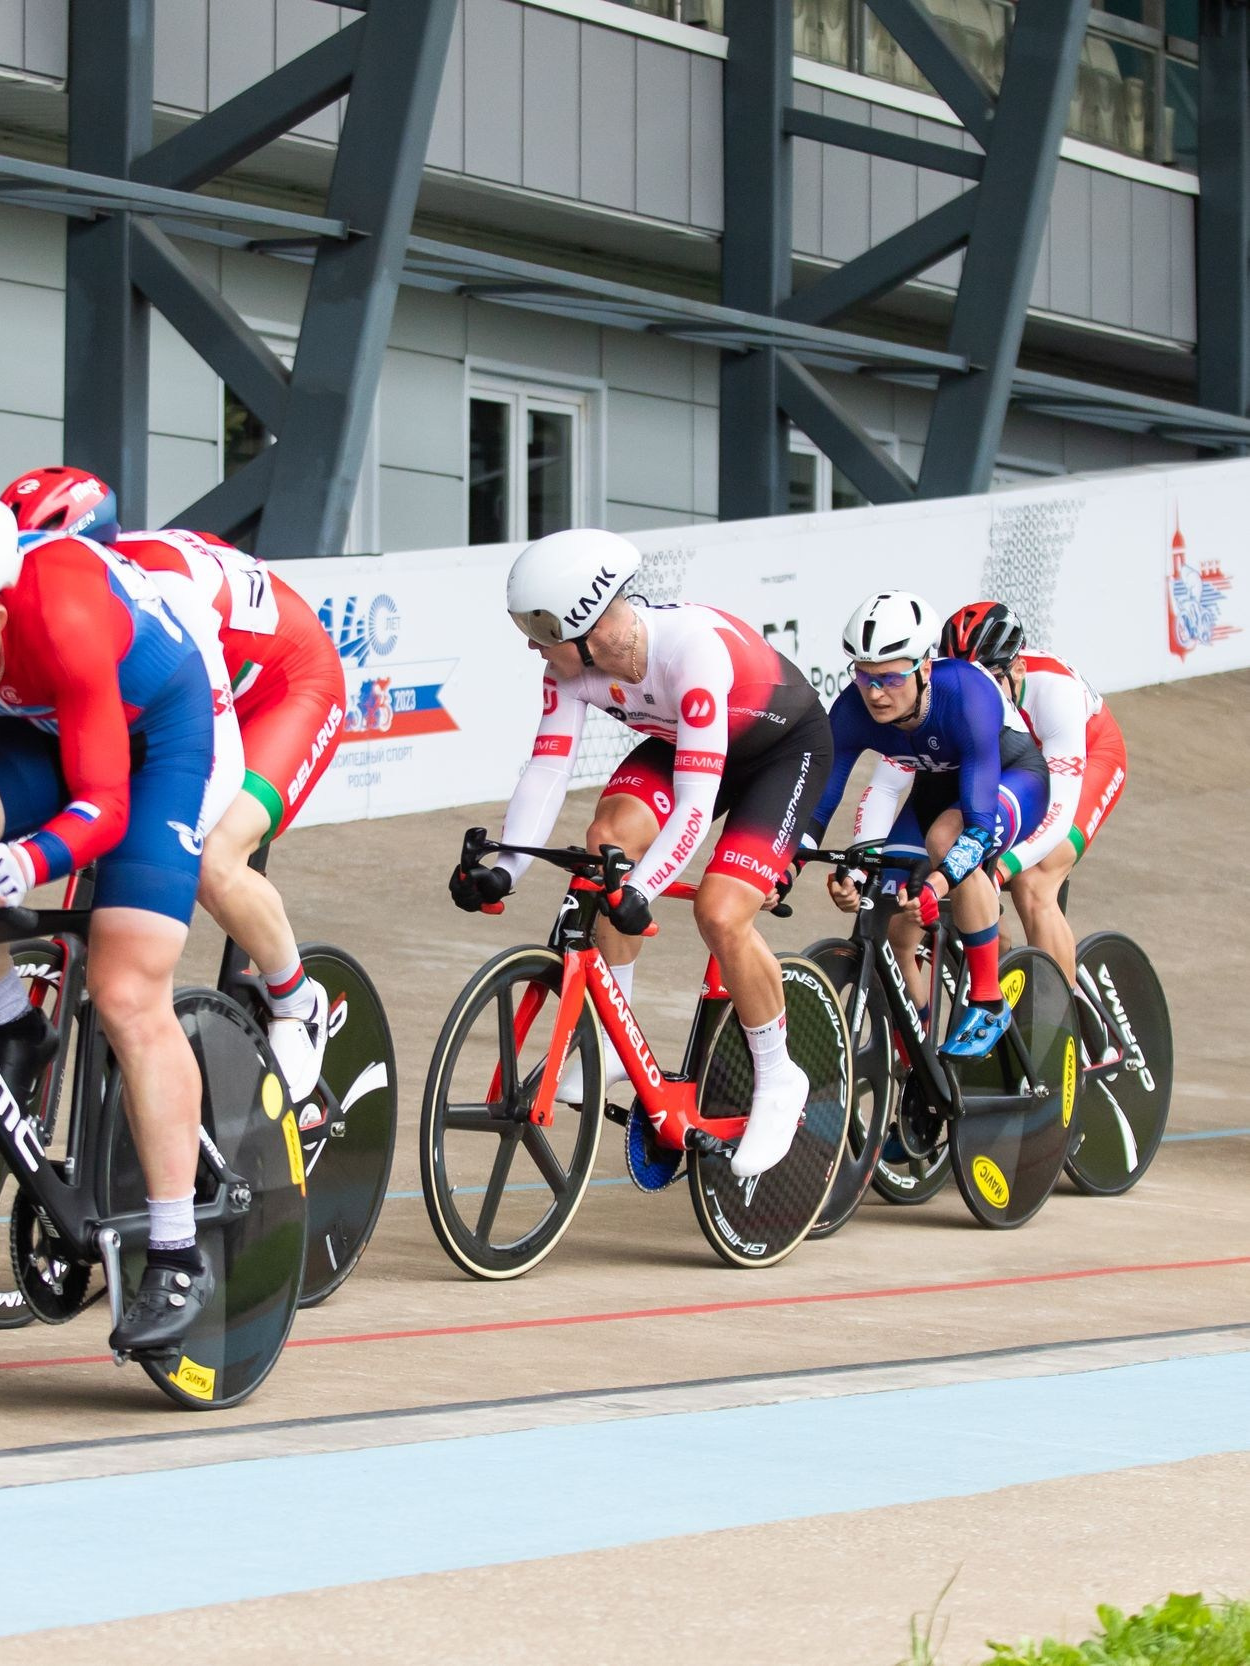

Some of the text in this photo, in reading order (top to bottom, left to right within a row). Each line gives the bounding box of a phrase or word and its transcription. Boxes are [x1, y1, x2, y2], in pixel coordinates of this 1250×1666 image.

[564, 566, 616, 628] KASK
[287, 703, 343, 806] BELARUS
[387, 746, 413, 762] СПОРТ
[675, 755, 724, 771] BIEMME
[1026, 802, 1063, 845] BELARUS
[1086, 767, 1126, 840] BELARUS
[647, 807, 704, 891] TULA REGION
[592, 953, 661, 1088] PINARELLO
[881, 939, 926, 1044] DOLAN
[1003, 979, 1019, 1003] VIC
[782, 968, 847, 1109] CAMPAGNO
[1063, 1053, 1075, 1111] MAVIC
[979, 1166, 1005, 1200] MAVIC
[185, 1371, 208, 1388] MAVIC
